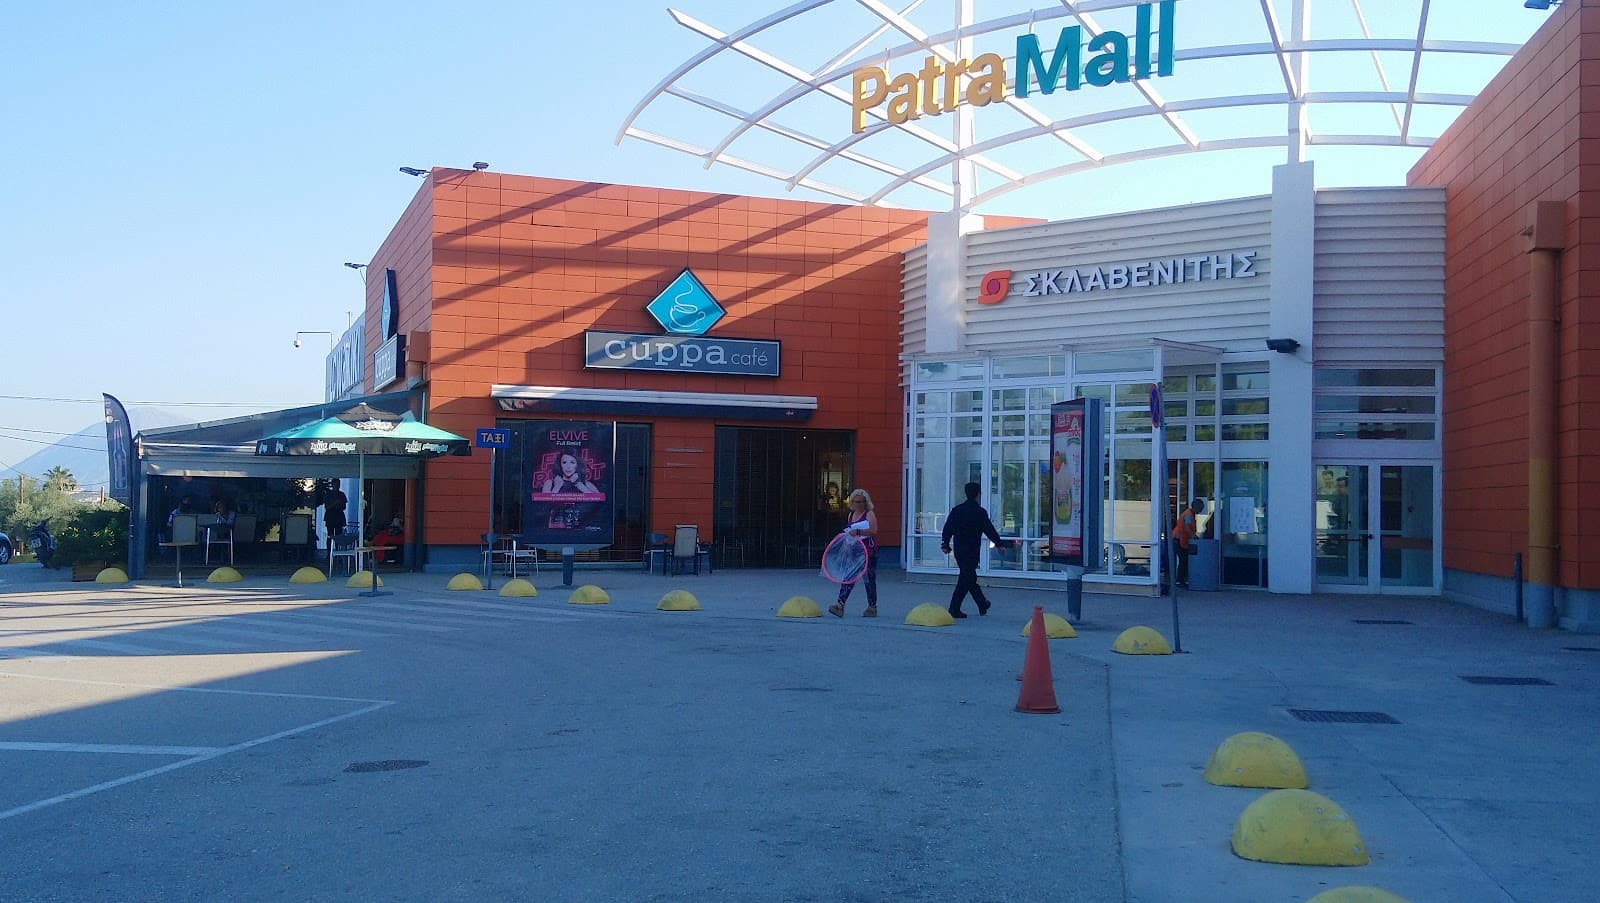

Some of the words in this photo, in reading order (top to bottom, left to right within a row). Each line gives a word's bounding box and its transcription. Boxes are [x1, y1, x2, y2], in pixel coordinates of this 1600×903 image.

[851, 52, 1006, 134] Patra
[1014, 0, 1175, 99] Mall
[1022, 251, 1257, 297] ΣΚΛΑΒΕΝΙΤΗΣ
[604, 339, 728, 368] cuppa
[730, 347, 768, 367] café
[549, 430, 589, 441] ELVIVE
